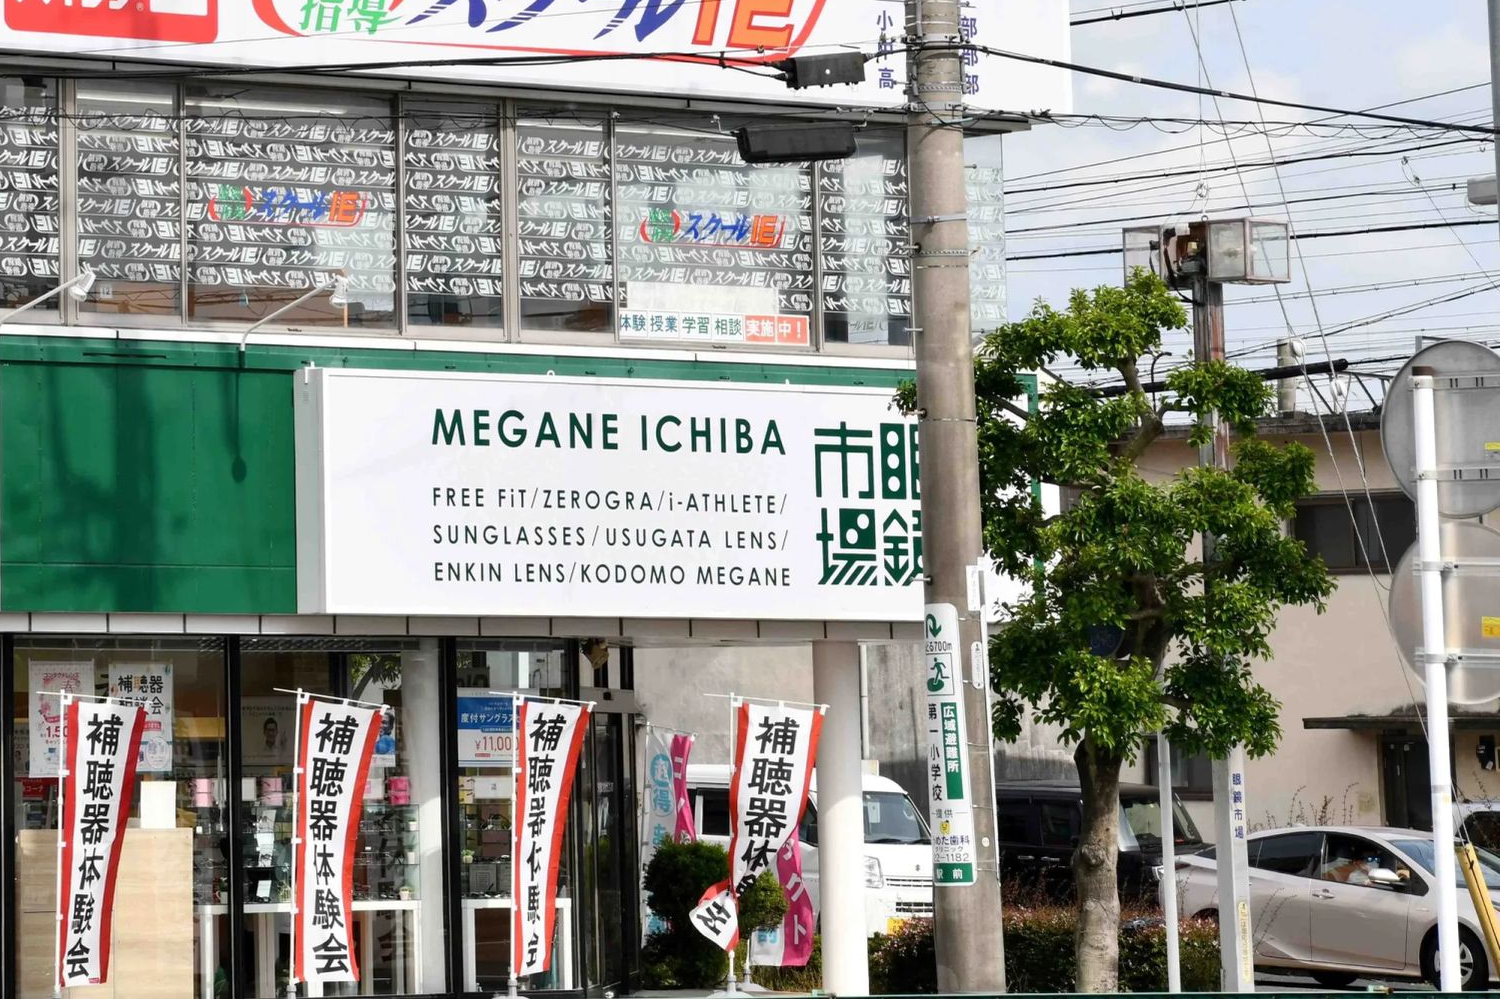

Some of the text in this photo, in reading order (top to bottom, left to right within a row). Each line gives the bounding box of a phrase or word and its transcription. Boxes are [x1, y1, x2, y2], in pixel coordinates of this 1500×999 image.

[680, 213, 778, 245] スクールIE
[431, 408, 786, 455] MEGANE ICHIBA
[432, 487, 788, 516] FREE FiT/ZEROGRA/i-ATHLETE/
[432, 523, 789, 552] SUNGLASSES/USUGATA LENS/
[434, 561, 792, 588] ENKIN LENS/KODOMO MEGANE
[118, 674, 163, 694] 補聴器
[927, 703, 943, 801] 第一小学校
[942, 705, 960, 773] 広域避難所
[67, 712, 123, 980] 補聴器体験会
[310, 712, 359, 976] 補聴器体験会
